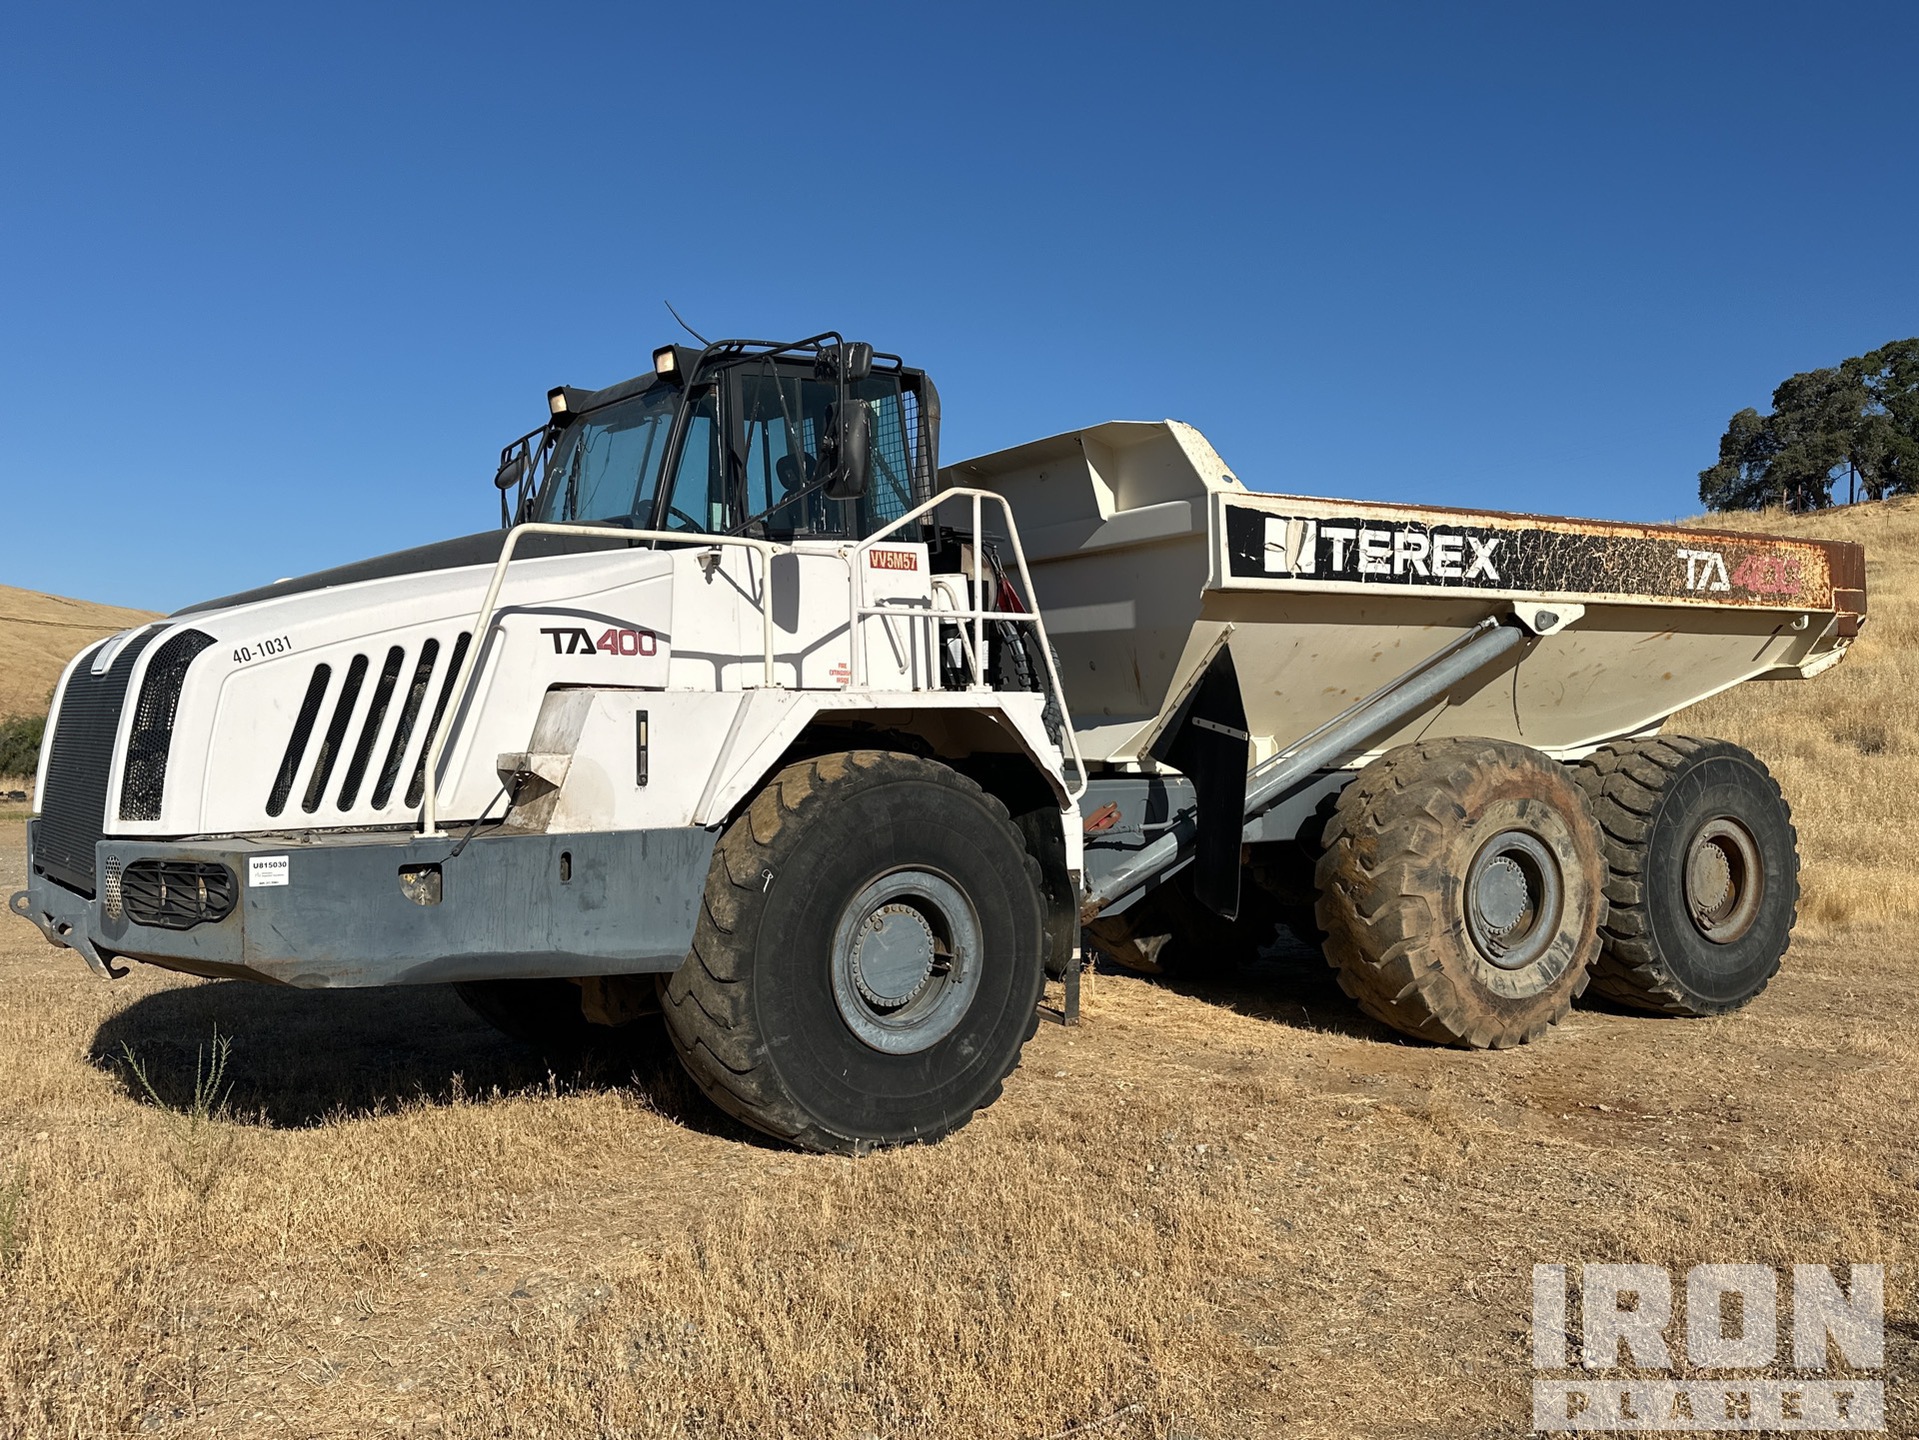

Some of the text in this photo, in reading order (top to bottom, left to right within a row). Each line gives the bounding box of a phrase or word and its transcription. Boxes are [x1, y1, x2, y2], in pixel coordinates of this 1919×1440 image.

[870, 551, 916, 569] VV5M57
[1320, 526, 1501, 580] TEREX
[233, 635, 292, 663] 40-1031
[540, 627, 657, 656] TA400
[253, 861, 287, 869] U815030
